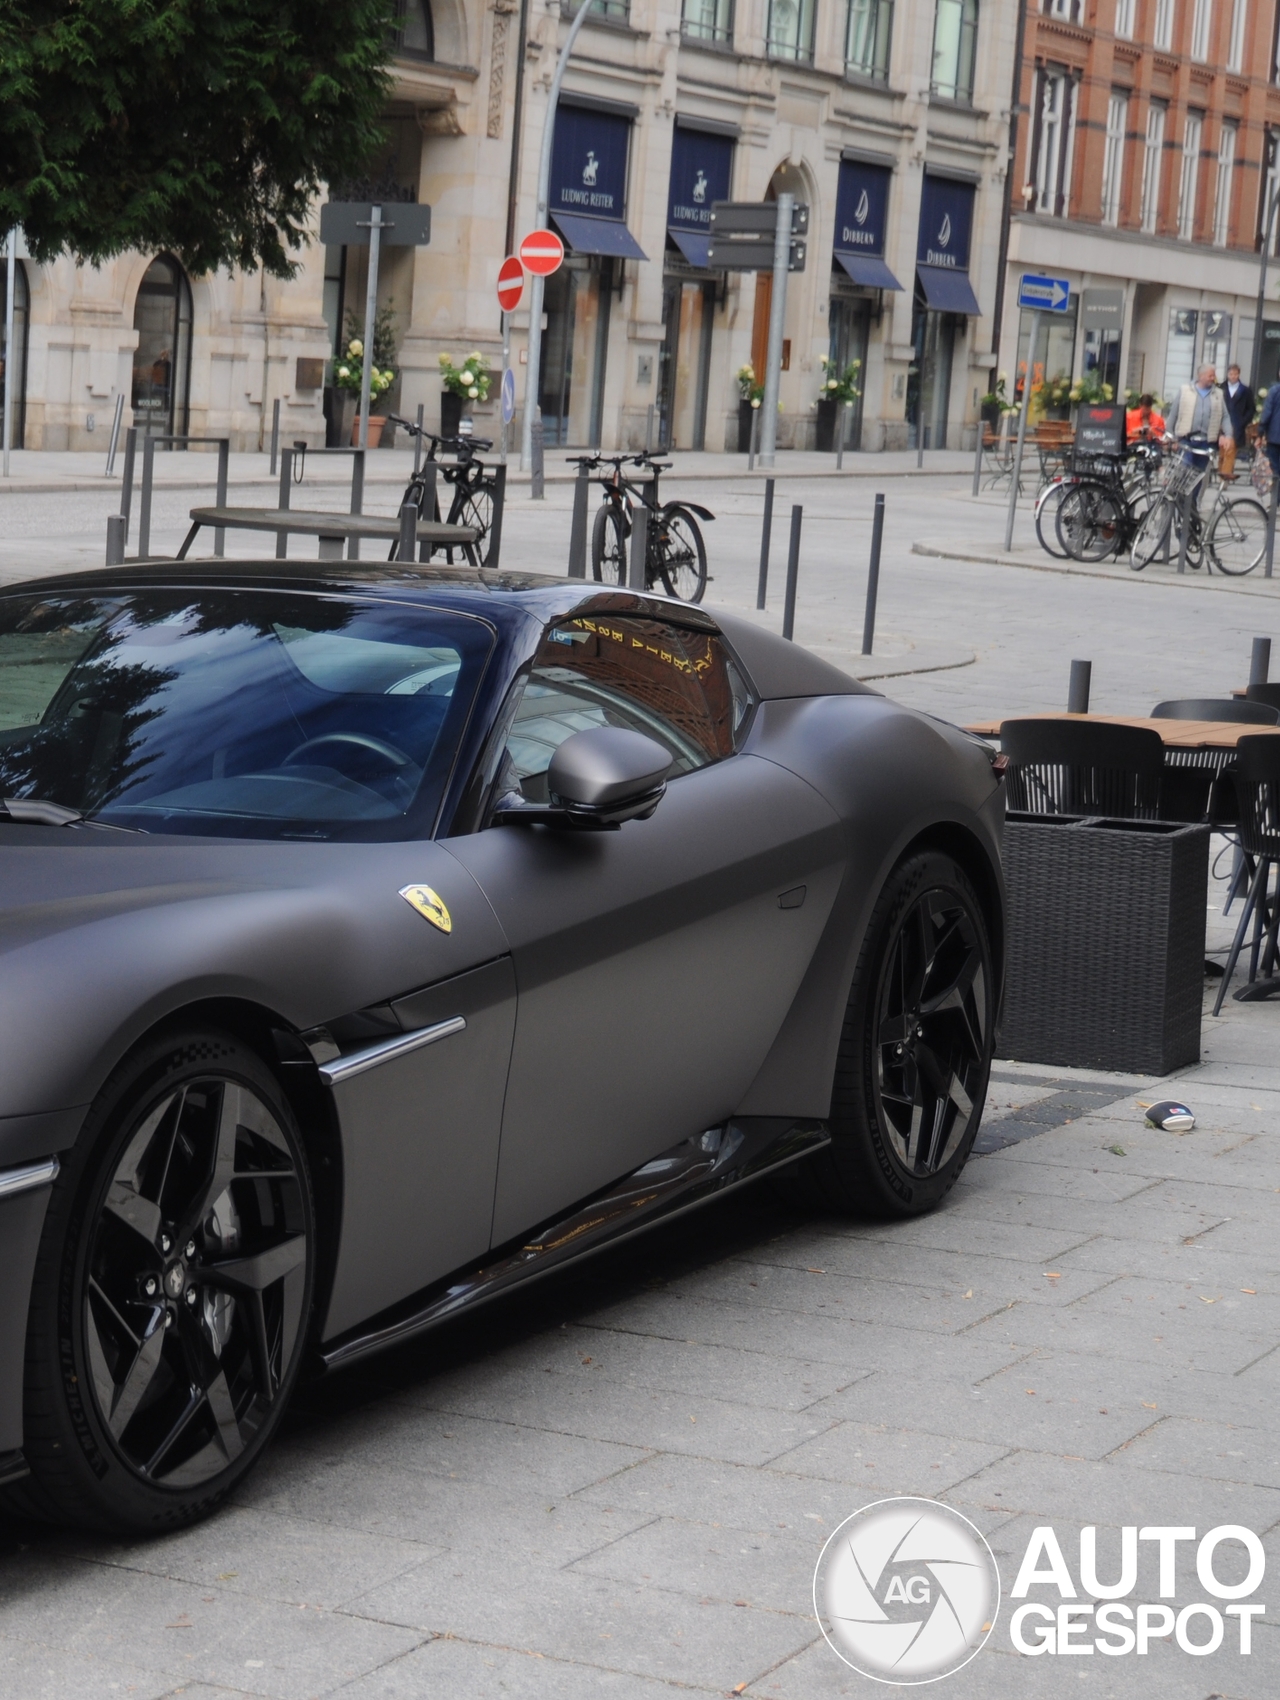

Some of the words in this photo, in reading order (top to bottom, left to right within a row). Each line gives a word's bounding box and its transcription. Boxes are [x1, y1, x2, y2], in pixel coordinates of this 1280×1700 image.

[561, 188, 589, 206] LUDWIG
[590, 192, 614, 209] REITER
[673, 205, 699, 222] LUDWIG
[699, 209, 710, 223] REI
[842, 226, 874, 245] DIBBERN
[926, 249, 956, 266] DIBBERN
[869, 1118, 902, 1191] MICHELIN
[60, 1337, 95, 1451] MICHELIN
